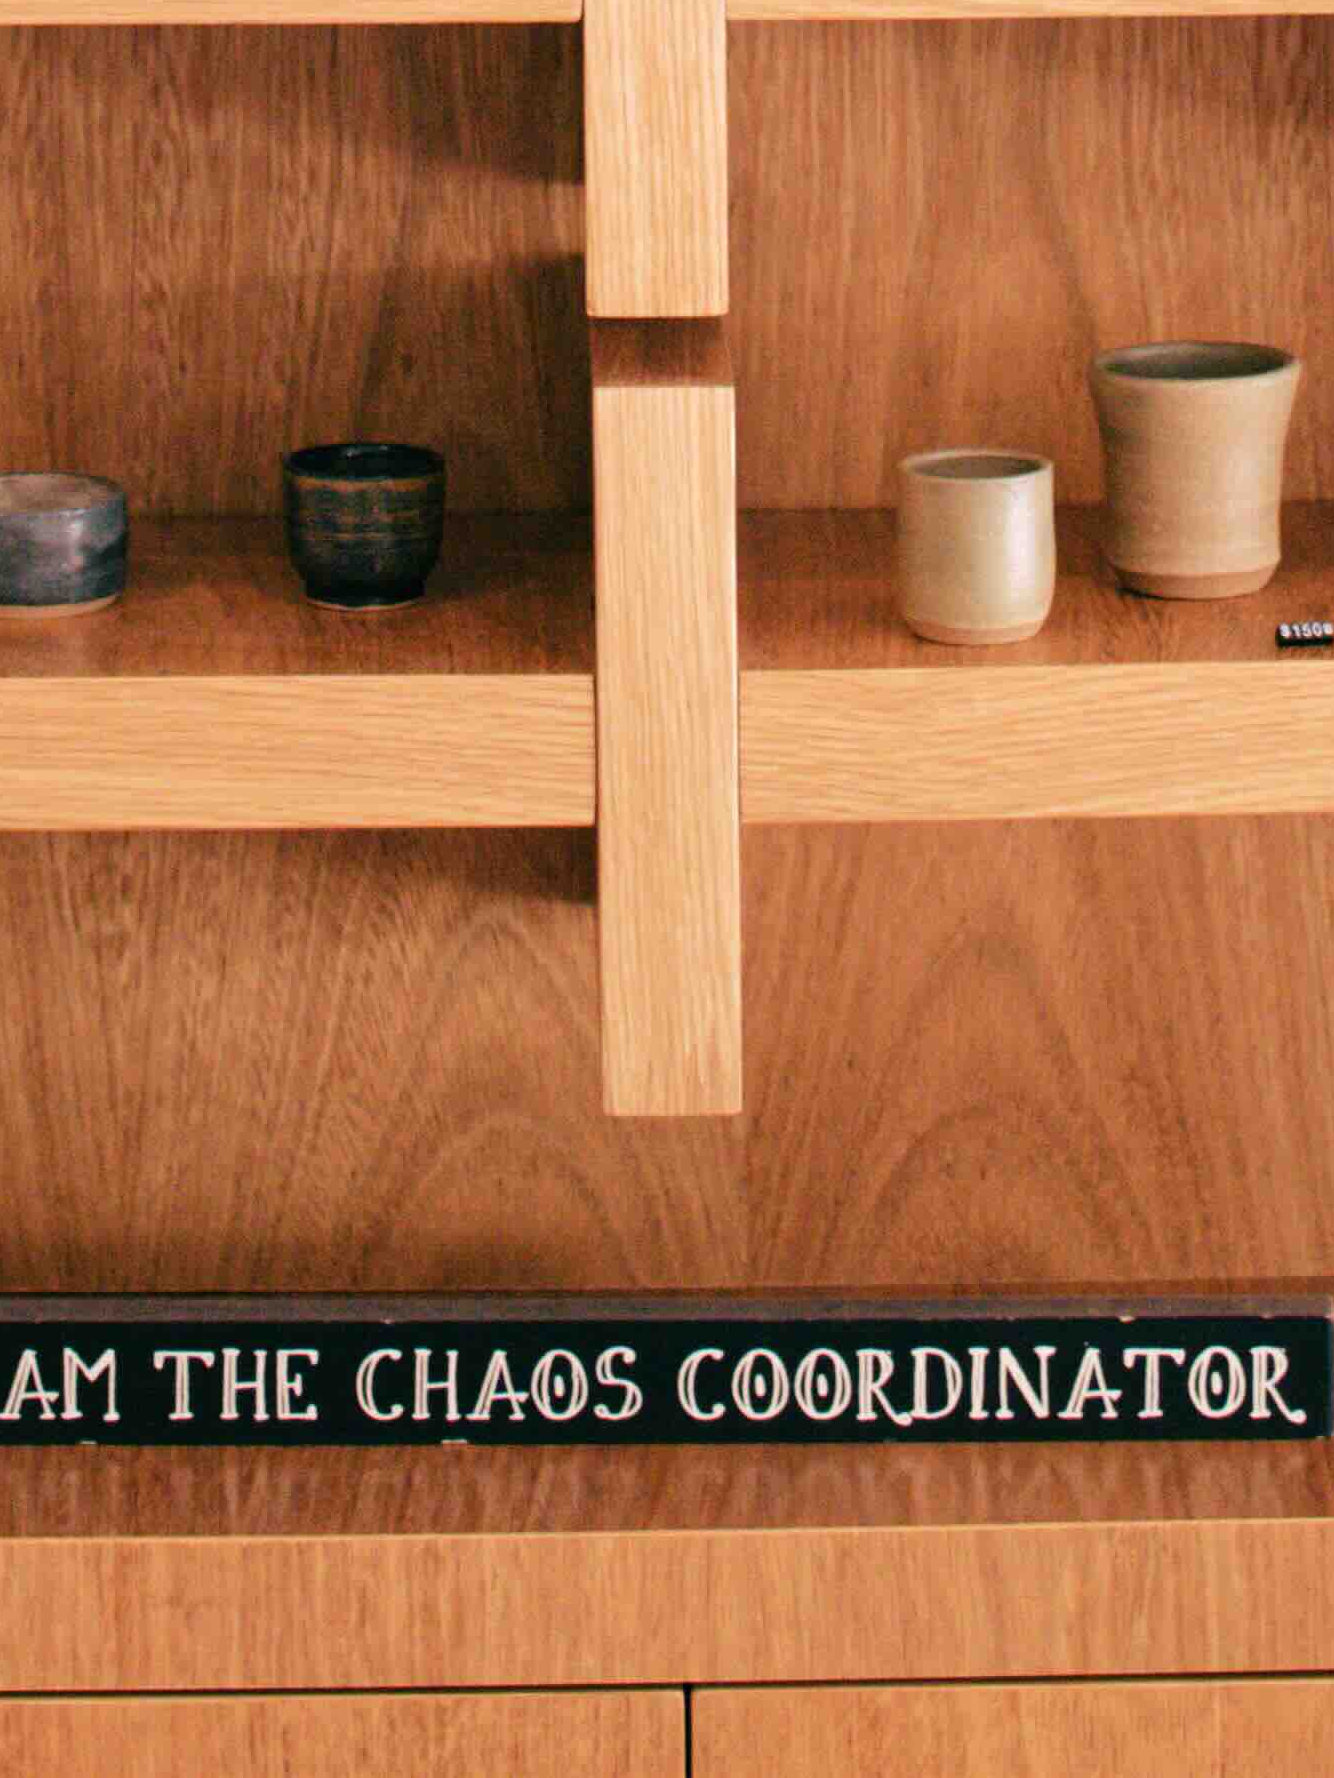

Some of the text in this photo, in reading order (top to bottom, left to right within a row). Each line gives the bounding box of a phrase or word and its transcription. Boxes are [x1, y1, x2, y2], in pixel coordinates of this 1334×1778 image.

[152, 1346, 320, 1423] THE
[355, 1344, 645, 1422] CHAOS
[676, 1344, 1308, 1428] COORDINATOR
